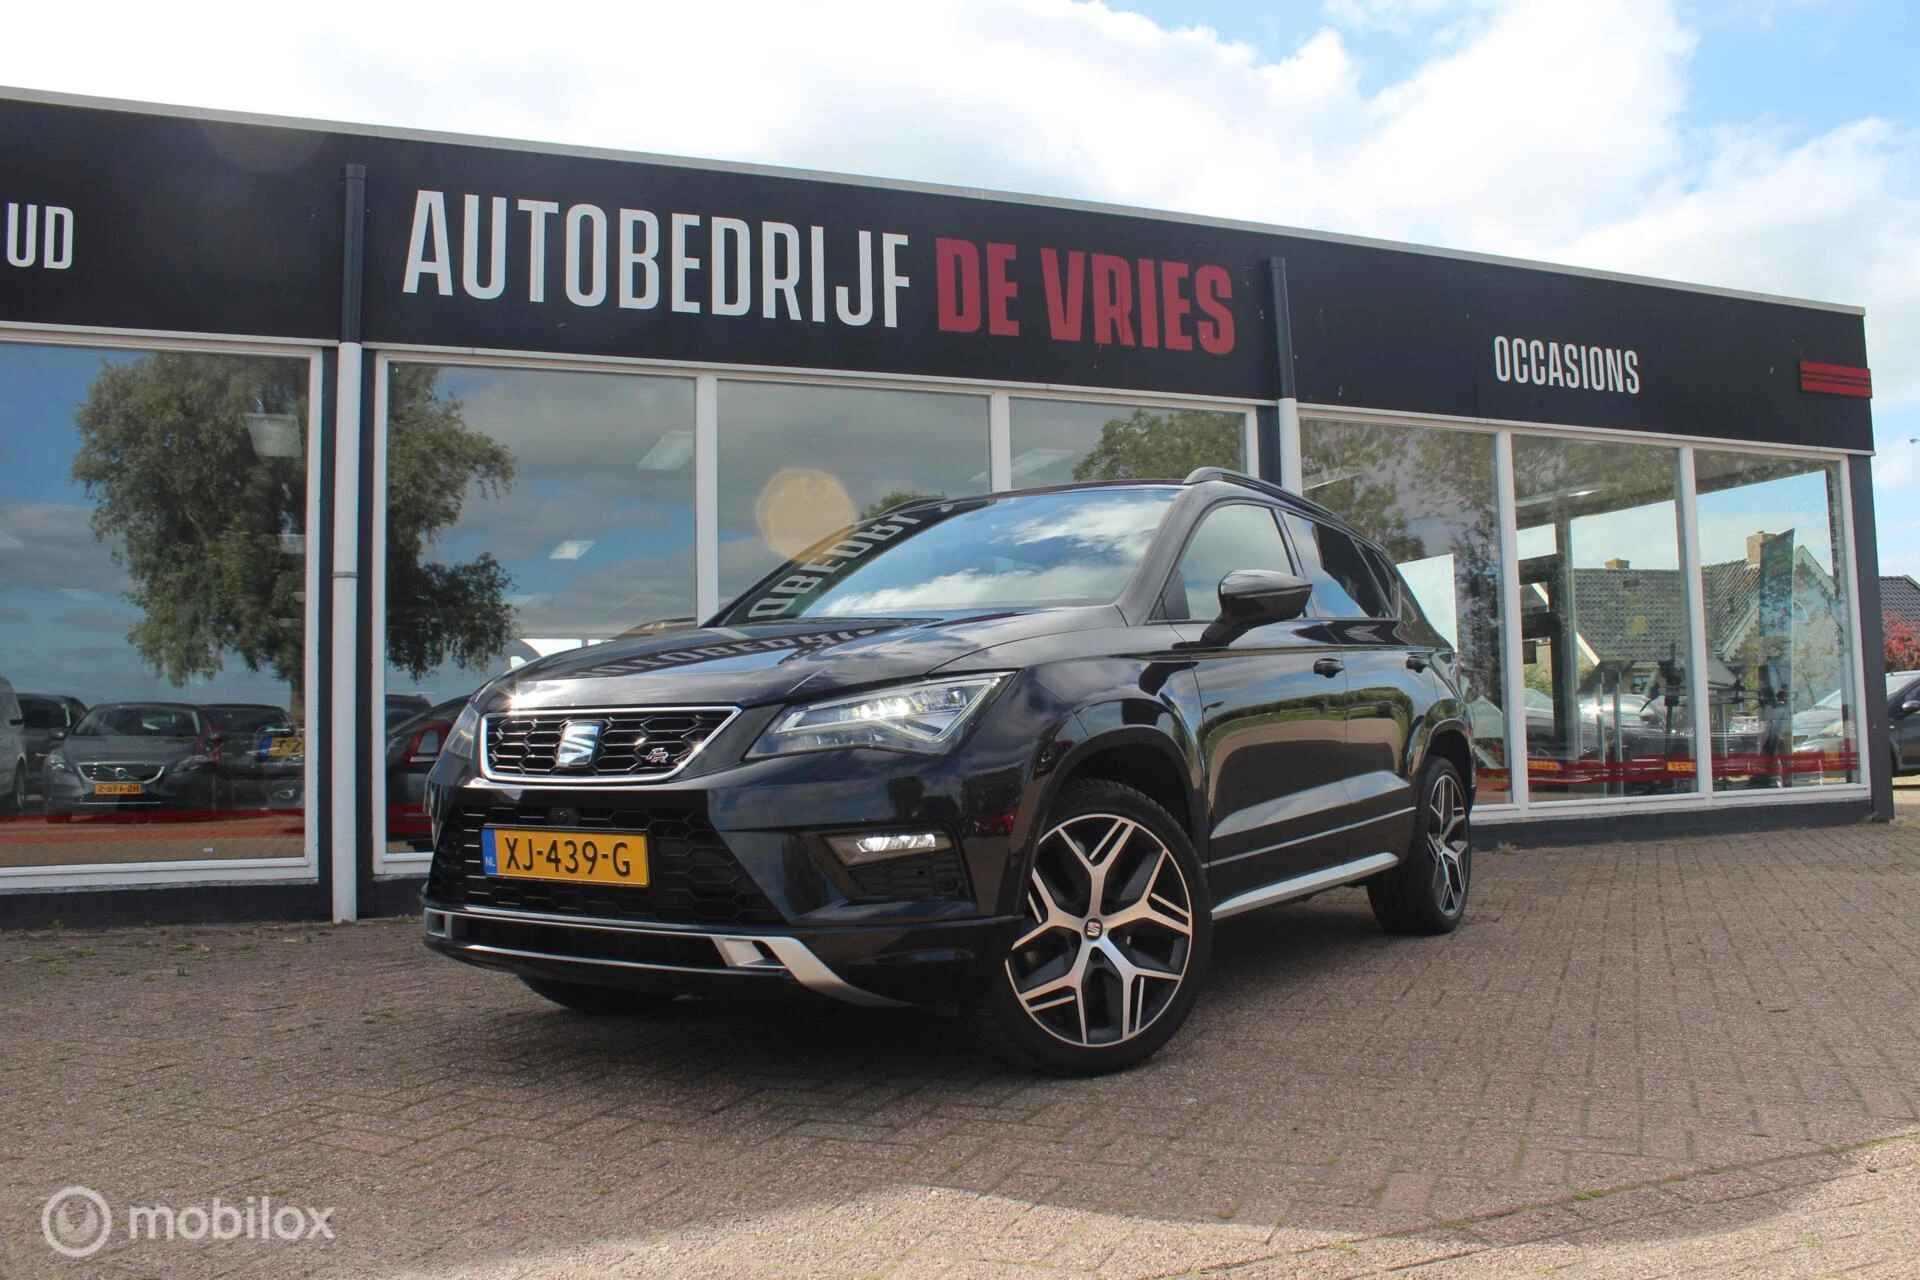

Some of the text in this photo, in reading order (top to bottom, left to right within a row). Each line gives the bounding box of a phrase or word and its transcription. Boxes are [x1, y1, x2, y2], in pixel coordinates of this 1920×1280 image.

[7, 202, 74, 270] UD
[403, 189, 1235, 354] AUTOBEDRIJF DE VRIES
[1494, 335, 1640, 395] OCCASIONS
[485, 837, 631, 877] NL XJ-439-G
